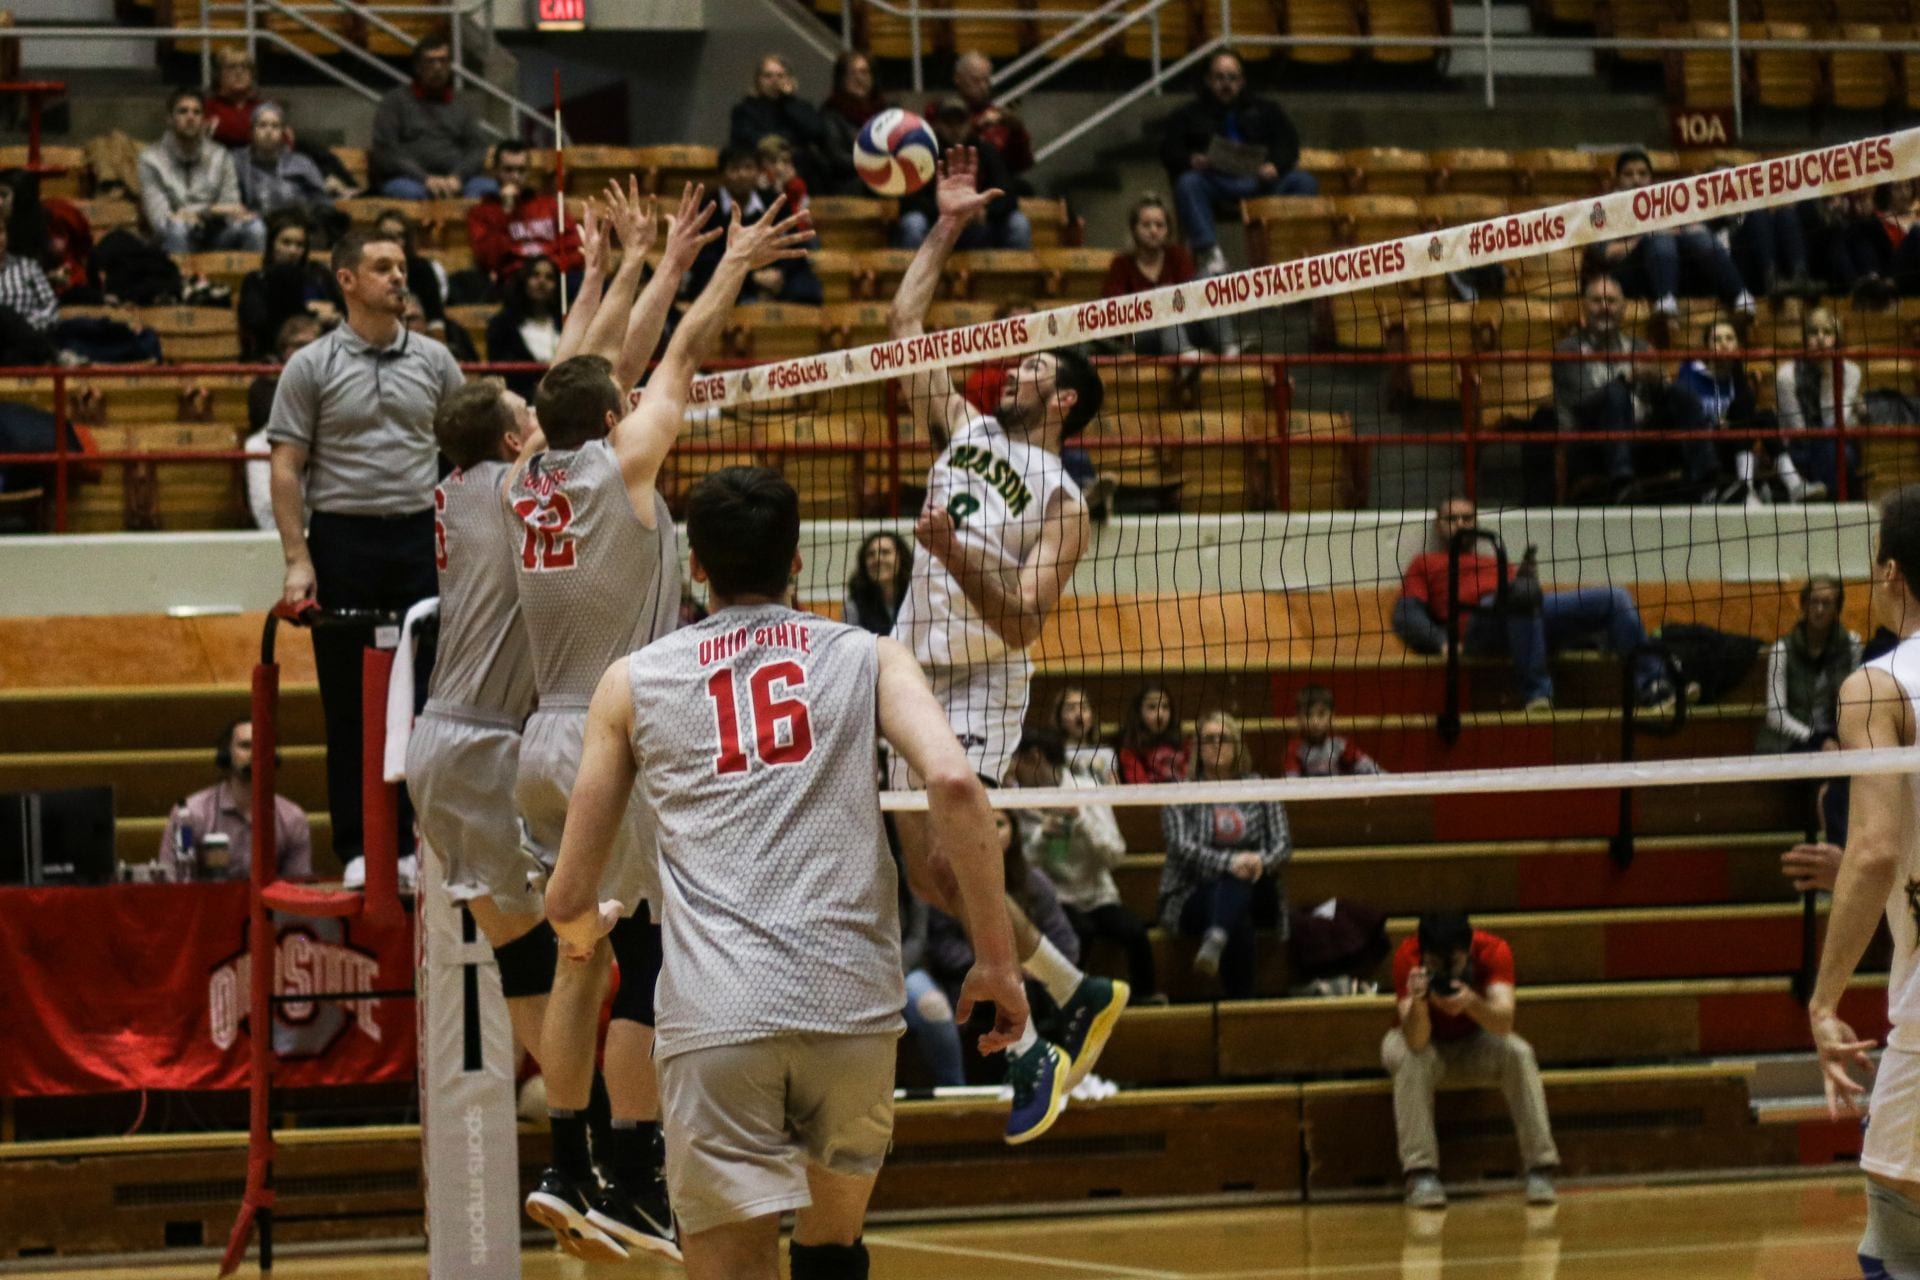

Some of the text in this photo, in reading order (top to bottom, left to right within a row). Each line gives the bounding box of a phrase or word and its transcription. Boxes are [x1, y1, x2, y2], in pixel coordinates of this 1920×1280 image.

[1677, 114, 1727, 143] 10A
[1632, 137, 1894, 222] OHIO STATE BUCKEYES
[1468, 212, 1566, 256] #GoBucks
[1204, 241, 1406, 307] OHIO STATE BUCKEYES
[1077, 294, 1153, 333] #GoBucks
[870, 318, 1029, 371] OHIO STATE BUCKEYES
[768, 359, 828, 391] #GoBucks
[947, 445, 1032, 519] MASON
[512, 489, 577, 572] 12
[705, 660, 815, 777] 16
